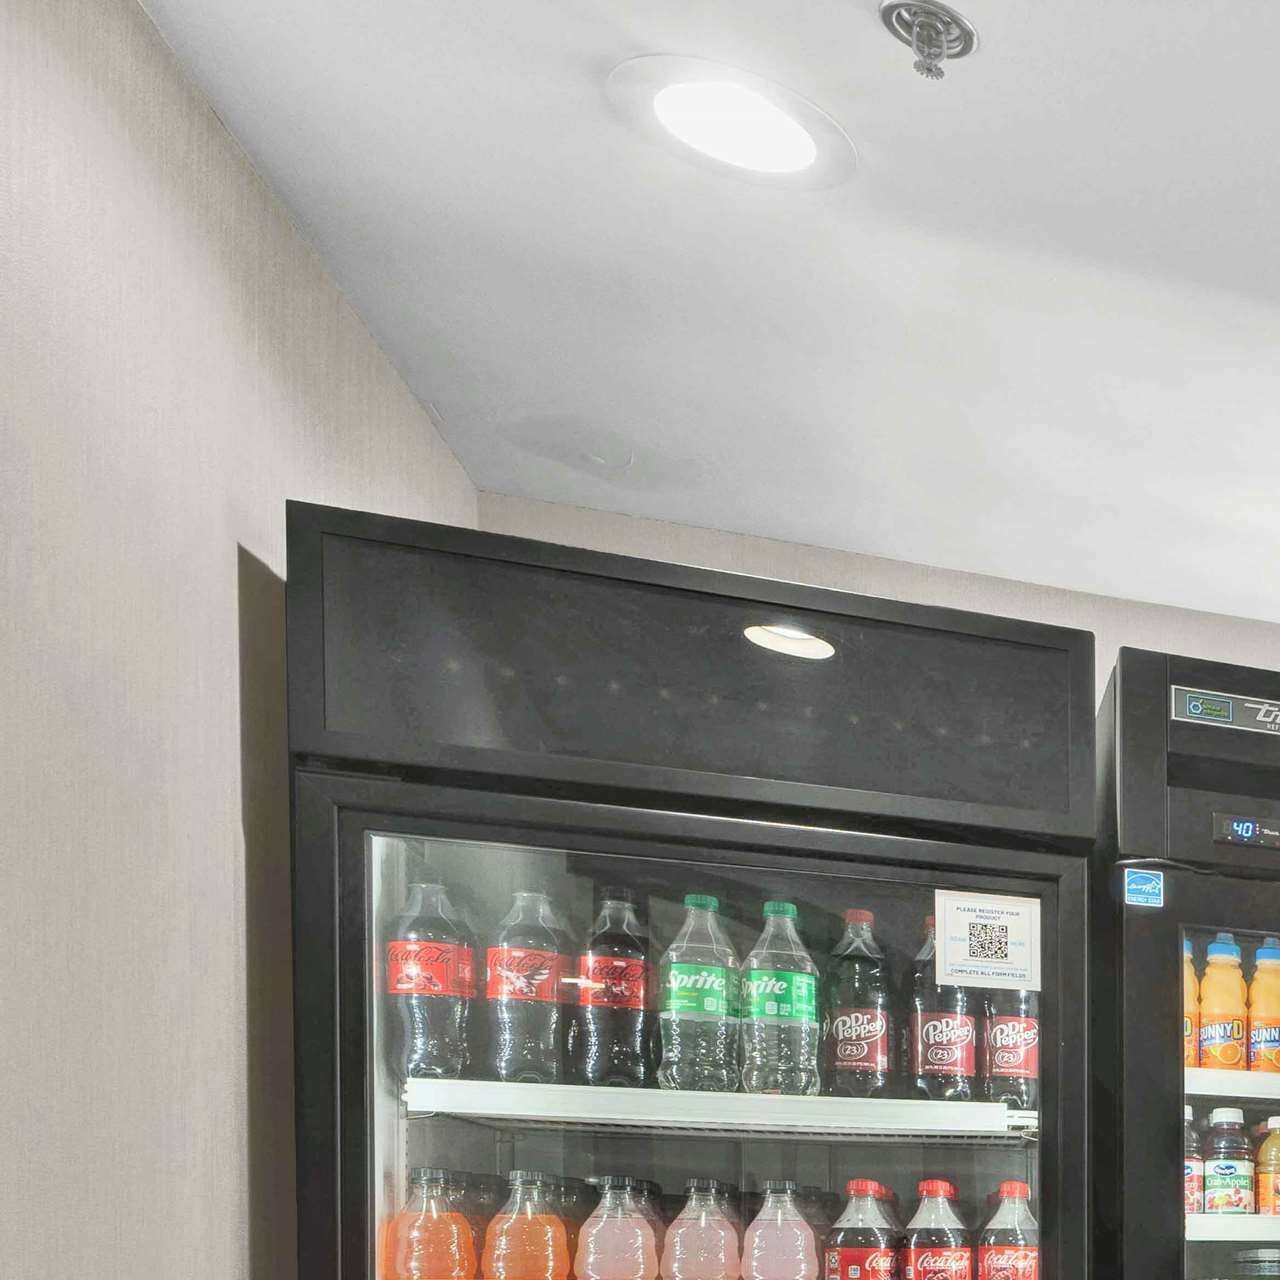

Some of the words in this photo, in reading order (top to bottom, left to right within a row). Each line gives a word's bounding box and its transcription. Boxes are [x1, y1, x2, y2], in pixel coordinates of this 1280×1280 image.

[1233, 822, 1253, 837] 40
[666, 970, 725, 994] Sprite
[851, 1013, 870, 1026] Dr
[942, 1018, 959, 1030] Dr
[834, 1020, 884, 1037] Pepper
[924, 1024, 971, 1042] Pepper
[846, 1045, 858, 1055] 23
